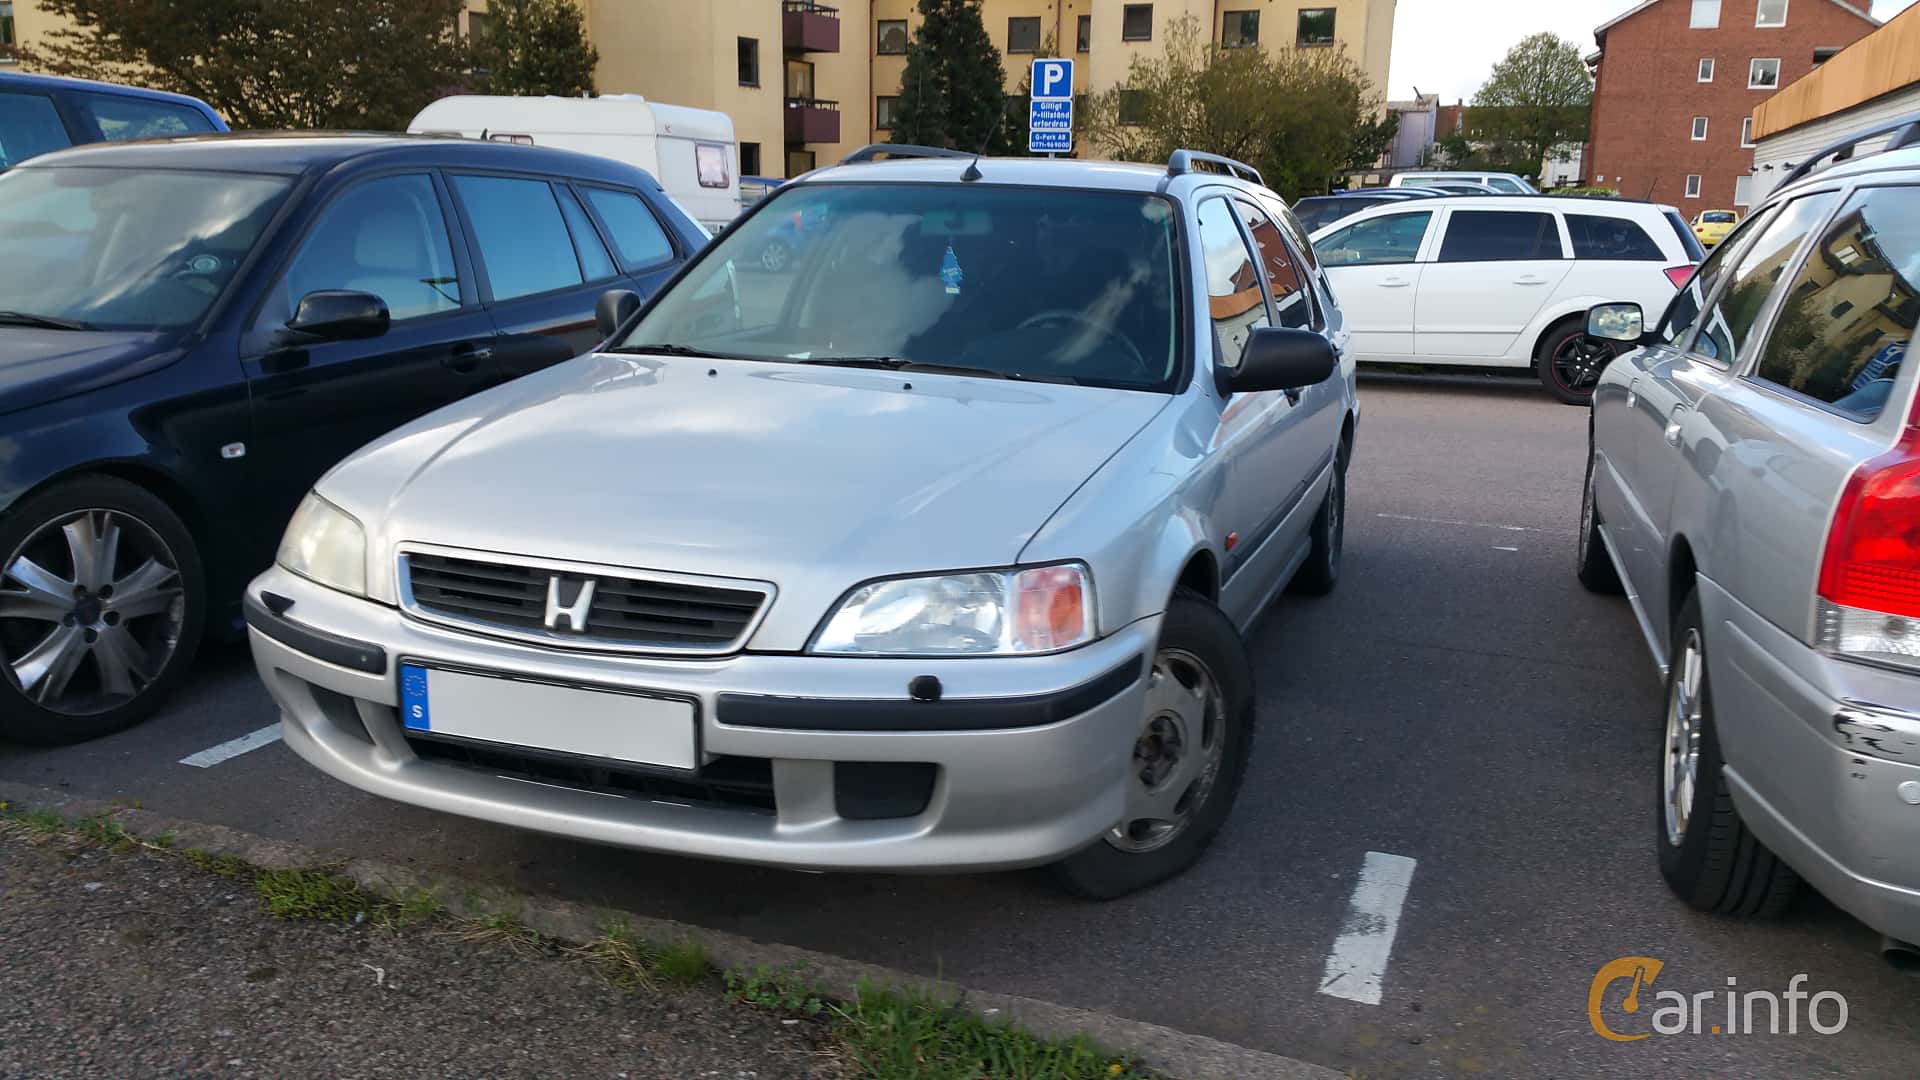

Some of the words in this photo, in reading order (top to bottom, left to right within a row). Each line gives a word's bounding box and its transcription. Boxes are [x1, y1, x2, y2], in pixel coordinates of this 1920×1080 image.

[1044, 63, 1064, 95] P
[1033, 119, 1068, 128] erfordras
[412, 704, 423, 718] S
